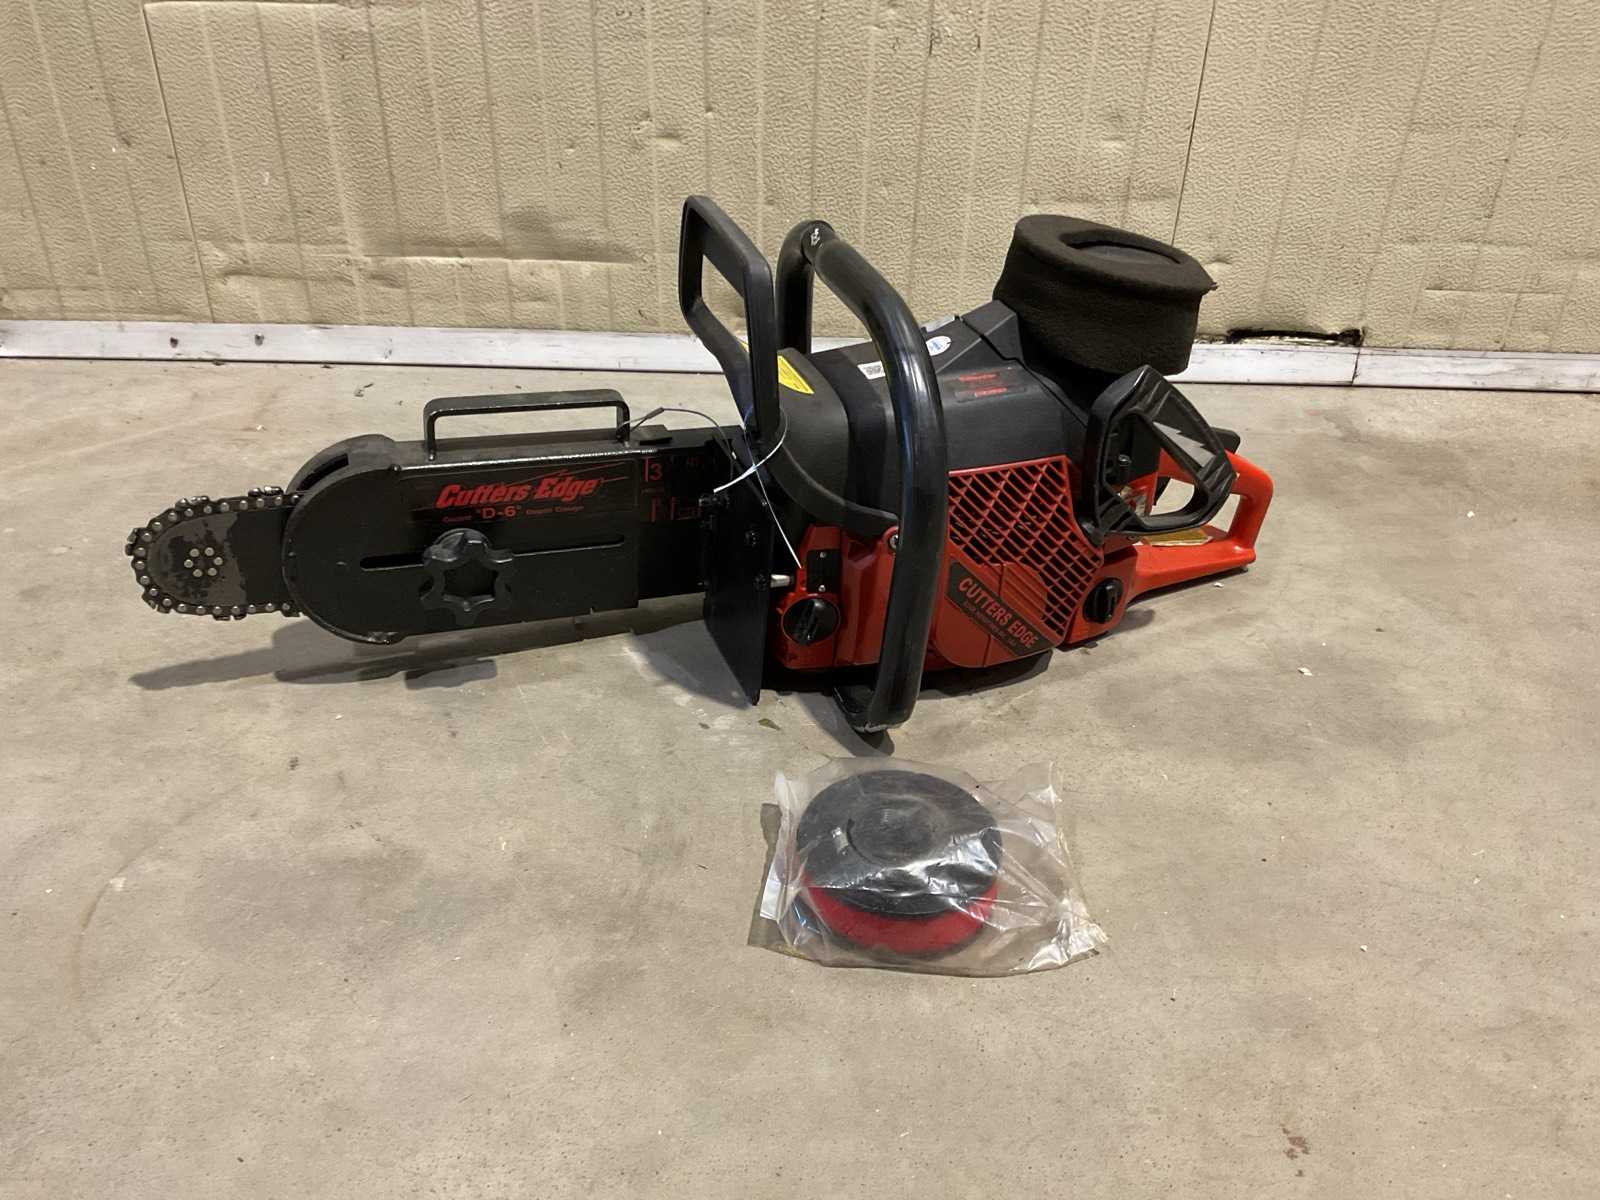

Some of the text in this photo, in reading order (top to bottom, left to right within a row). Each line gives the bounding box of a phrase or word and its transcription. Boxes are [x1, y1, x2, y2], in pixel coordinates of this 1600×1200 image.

[434, 476, 601, 509] Cutters Edge
[959, 577, 1012, 625] CUTTERS
[1007, 621, 1038, 648] EDGE
